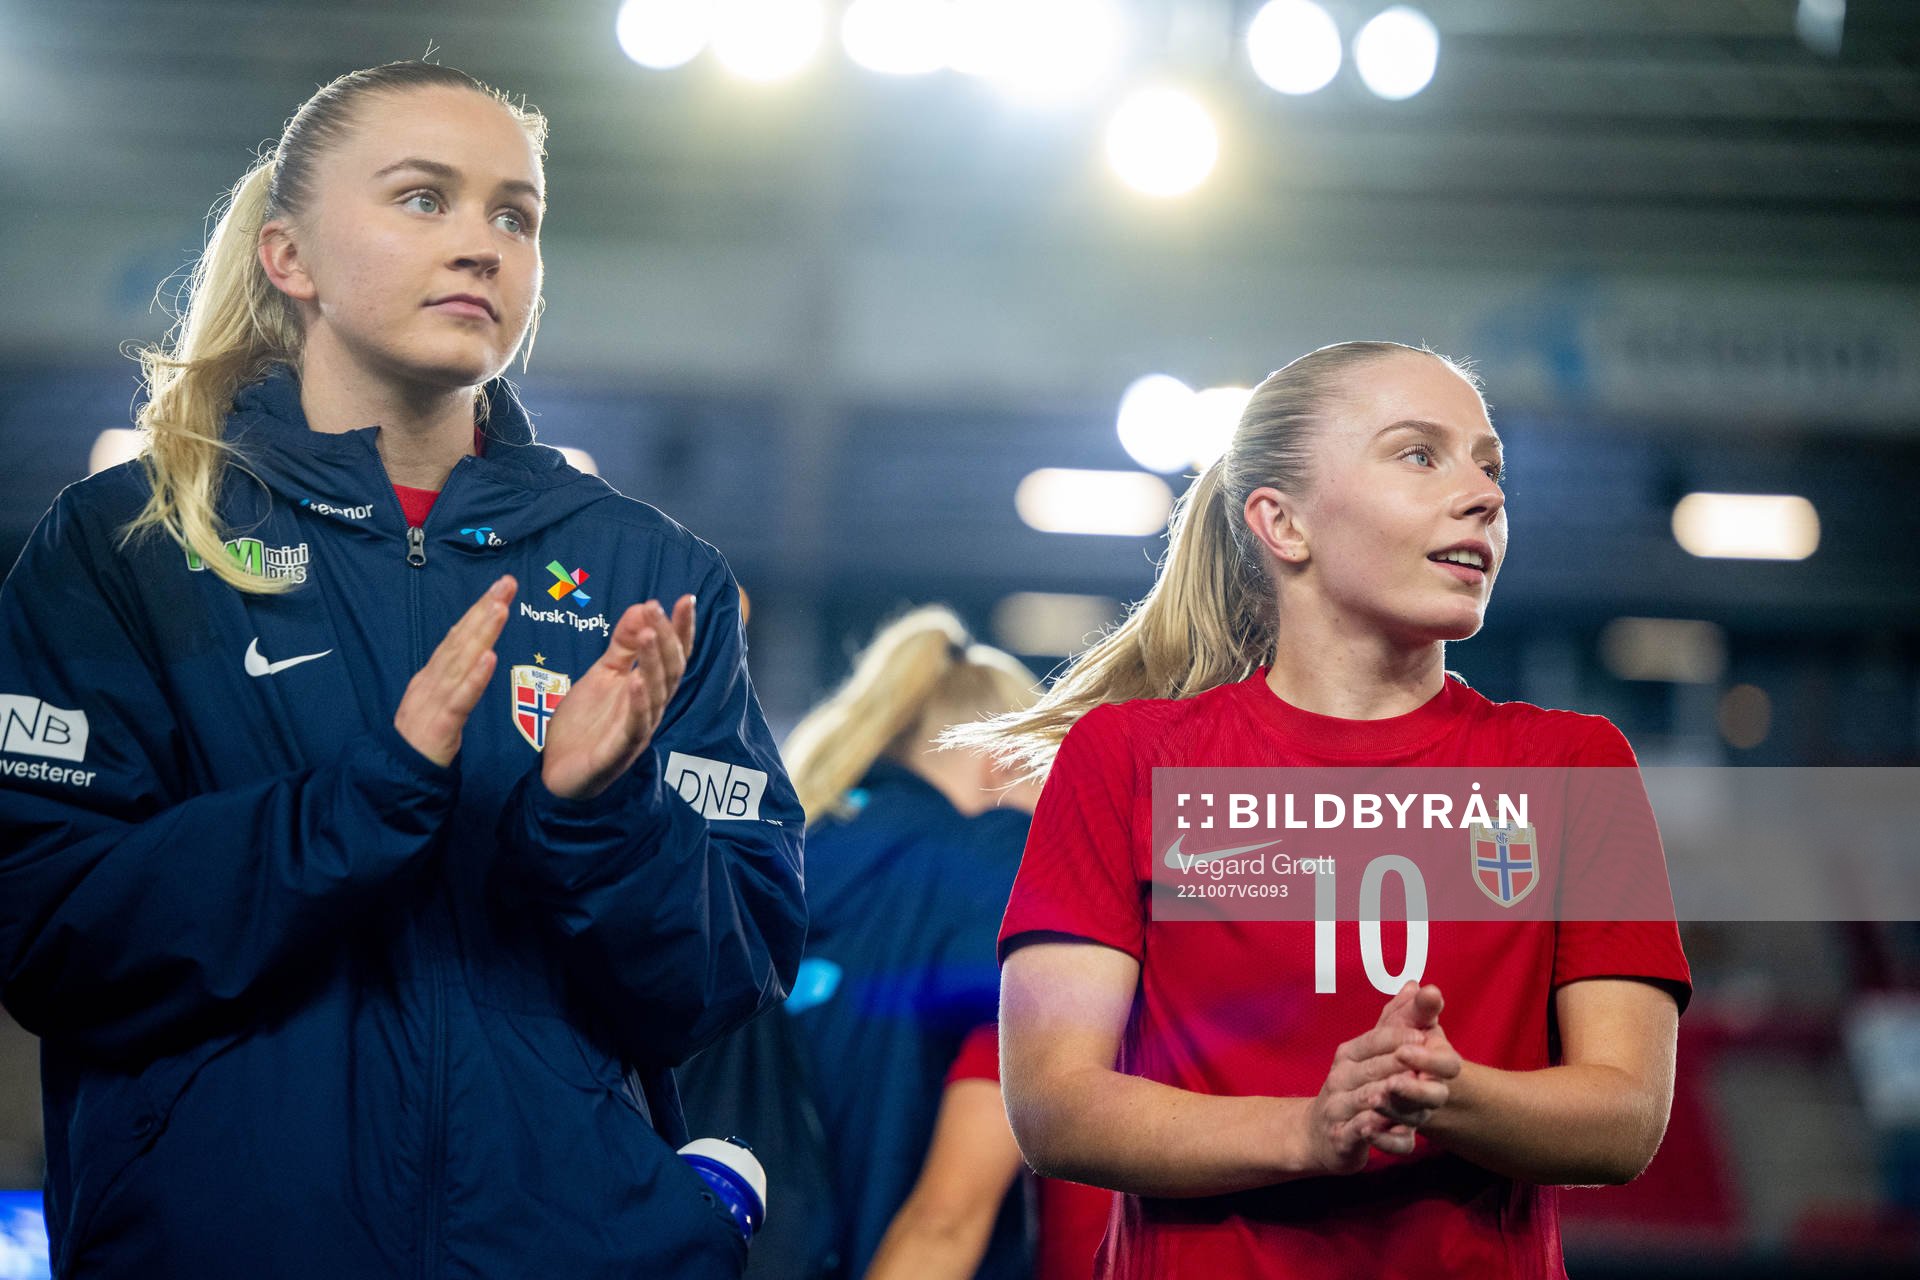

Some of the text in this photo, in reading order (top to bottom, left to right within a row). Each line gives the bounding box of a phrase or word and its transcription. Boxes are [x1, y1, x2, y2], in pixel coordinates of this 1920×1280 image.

[265, 543, 309, 565] mini
[520, 602, 565, 624] Norsk
[0, 697, 71, 751] NB
[0, 759, 96, 787] vesterer
[677, 764, 751, 817] DNB
[1300, 854, 1430, 996] 10
